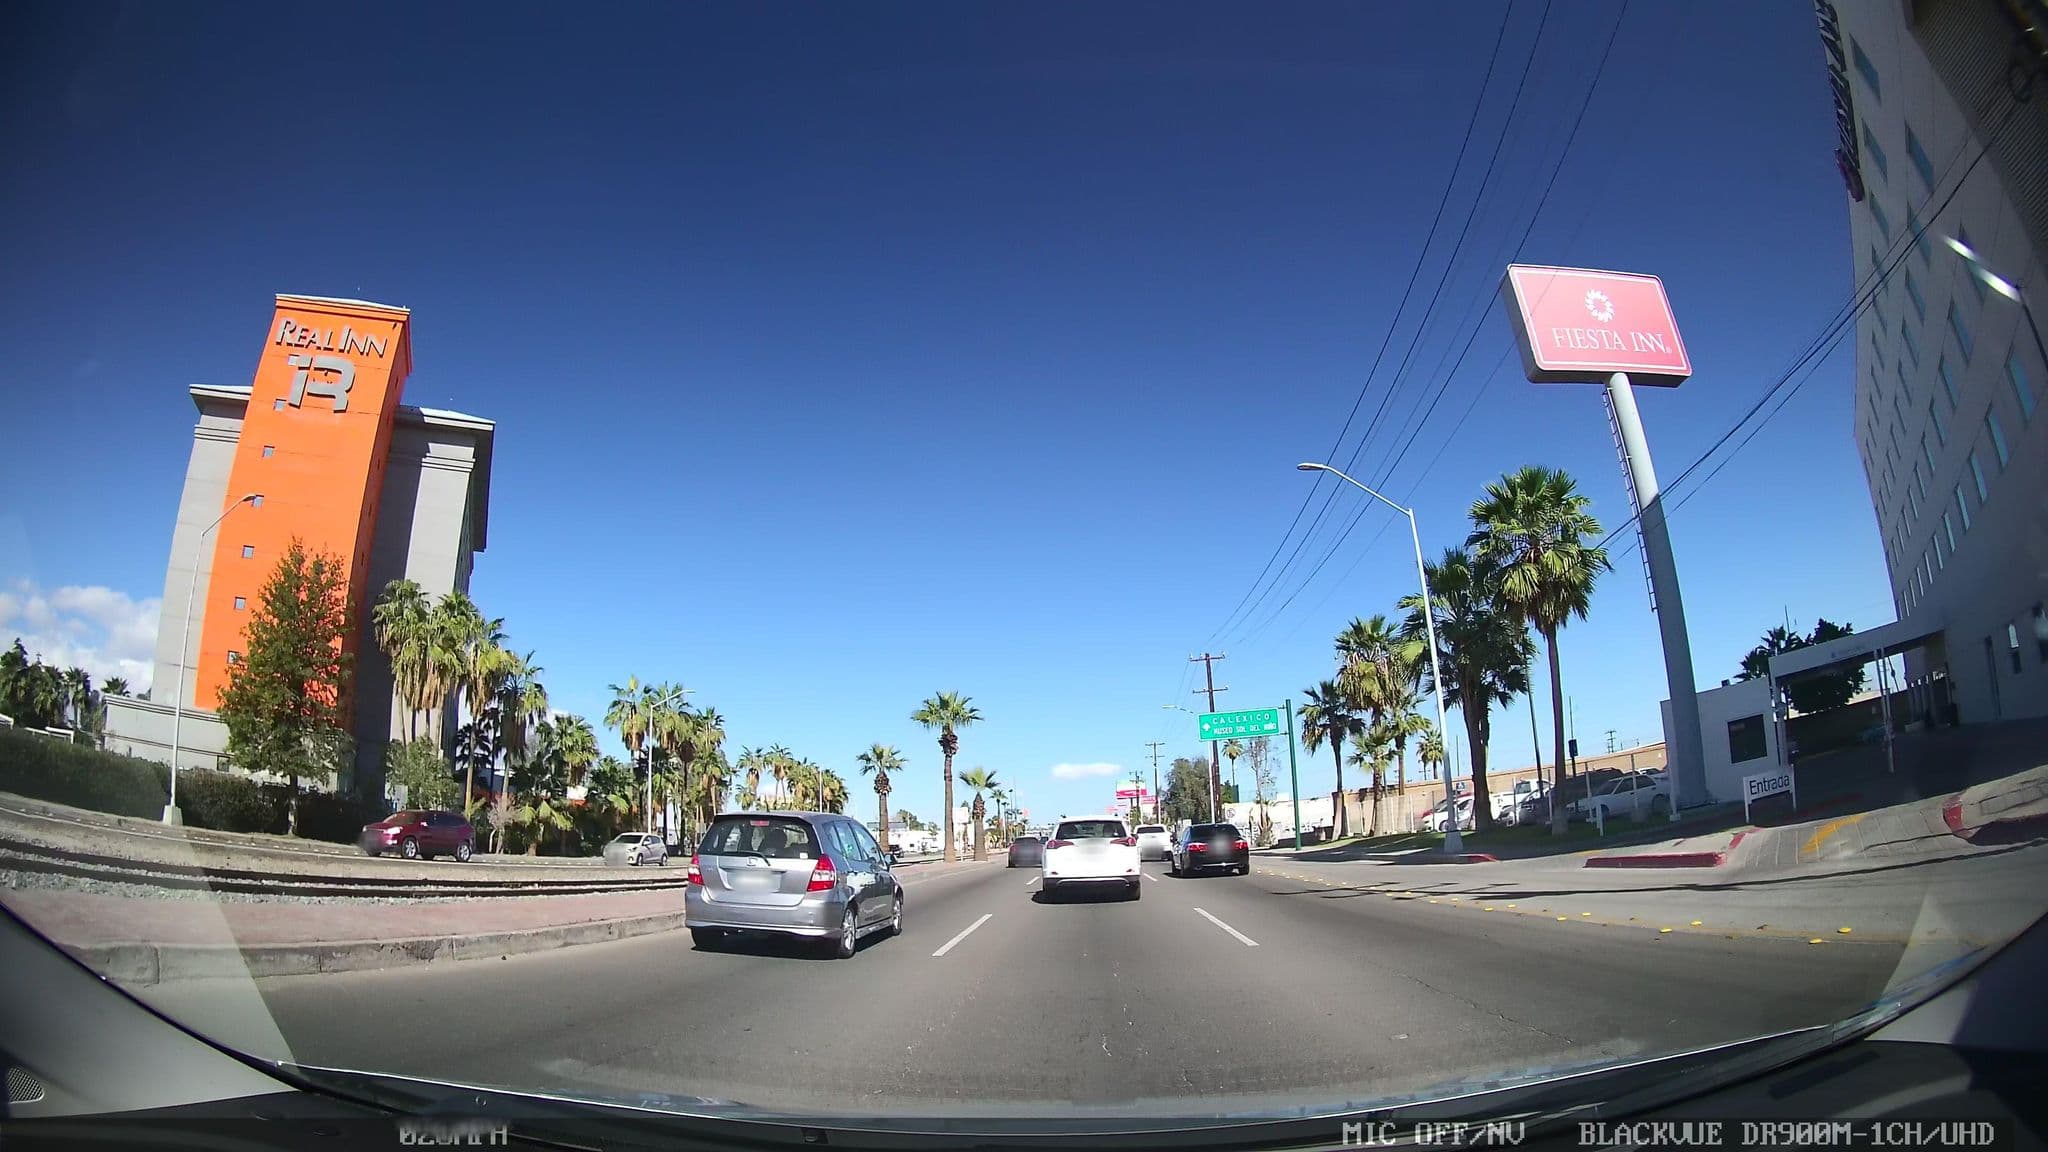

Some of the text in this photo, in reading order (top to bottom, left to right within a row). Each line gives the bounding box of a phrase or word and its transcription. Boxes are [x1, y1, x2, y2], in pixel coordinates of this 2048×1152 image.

[275, 318, 388, 358] REAL INN
[1551, 327, 1669, 354] FIESTA INN
[1212, 713, 1270, 725] CALEXICO
[1213, 726, 1233, 735] MUSEO
[1249, 724, 1261, 732] DEL
[1749, 775, 1790, 795] Entrada
